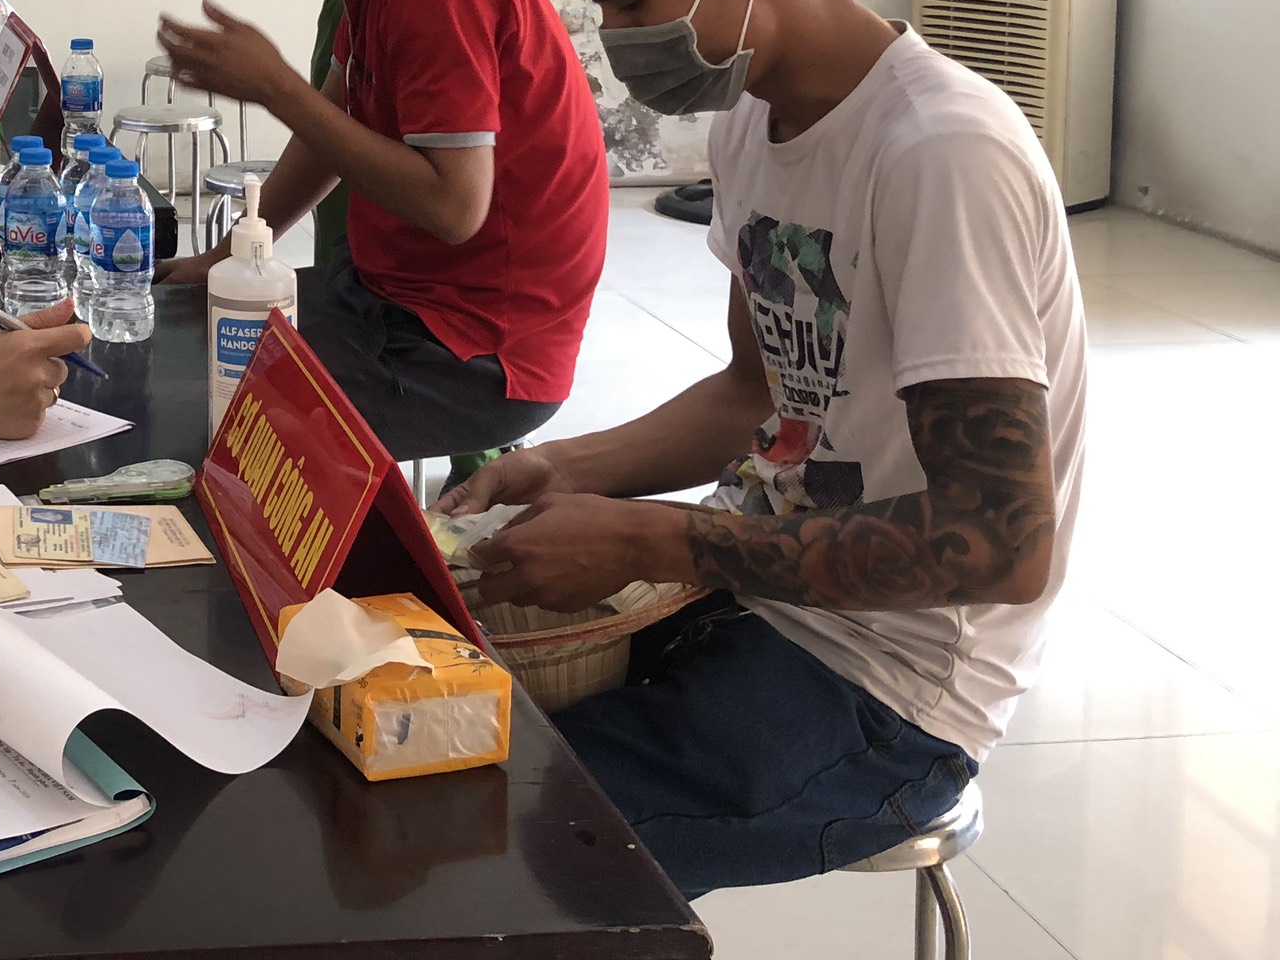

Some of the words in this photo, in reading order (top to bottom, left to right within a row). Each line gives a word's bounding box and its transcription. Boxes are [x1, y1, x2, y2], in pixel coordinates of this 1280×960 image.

[227, 392, 263, 458] CƠ
[238, 414, 286, 505] QUAN
[263, 455, 314, 558] CÔNG
[290, 507, 334, 590] AN
